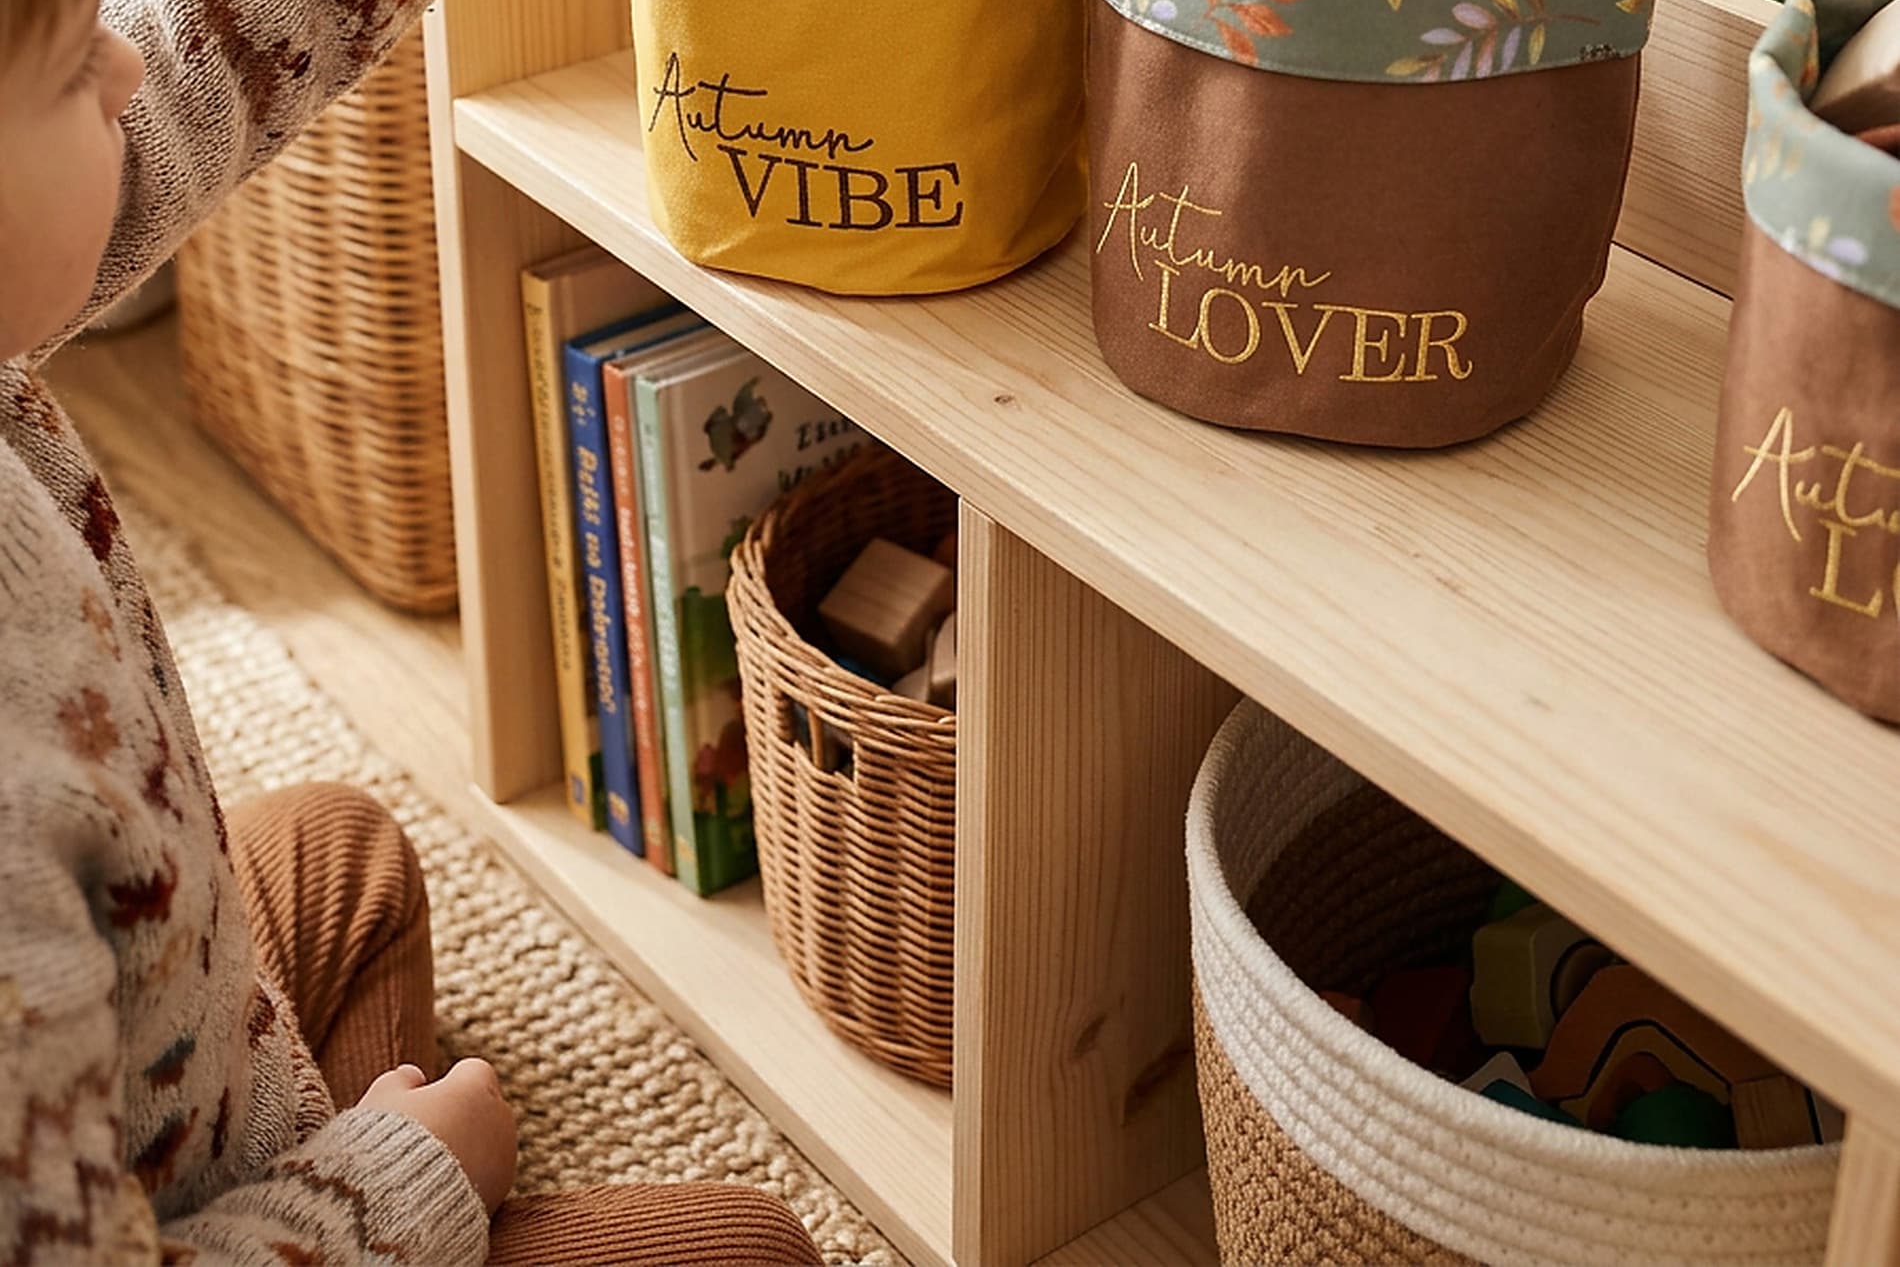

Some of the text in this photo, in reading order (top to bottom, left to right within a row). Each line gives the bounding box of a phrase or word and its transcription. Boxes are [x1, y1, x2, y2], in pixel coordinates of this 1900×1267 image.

[648, 51, 874, 163] Autumn
[716, 143, 964, 232] VIBE
[1095, 161, 1331, 299] Autumn
[1147, 260, 1474, 384] LOVER
